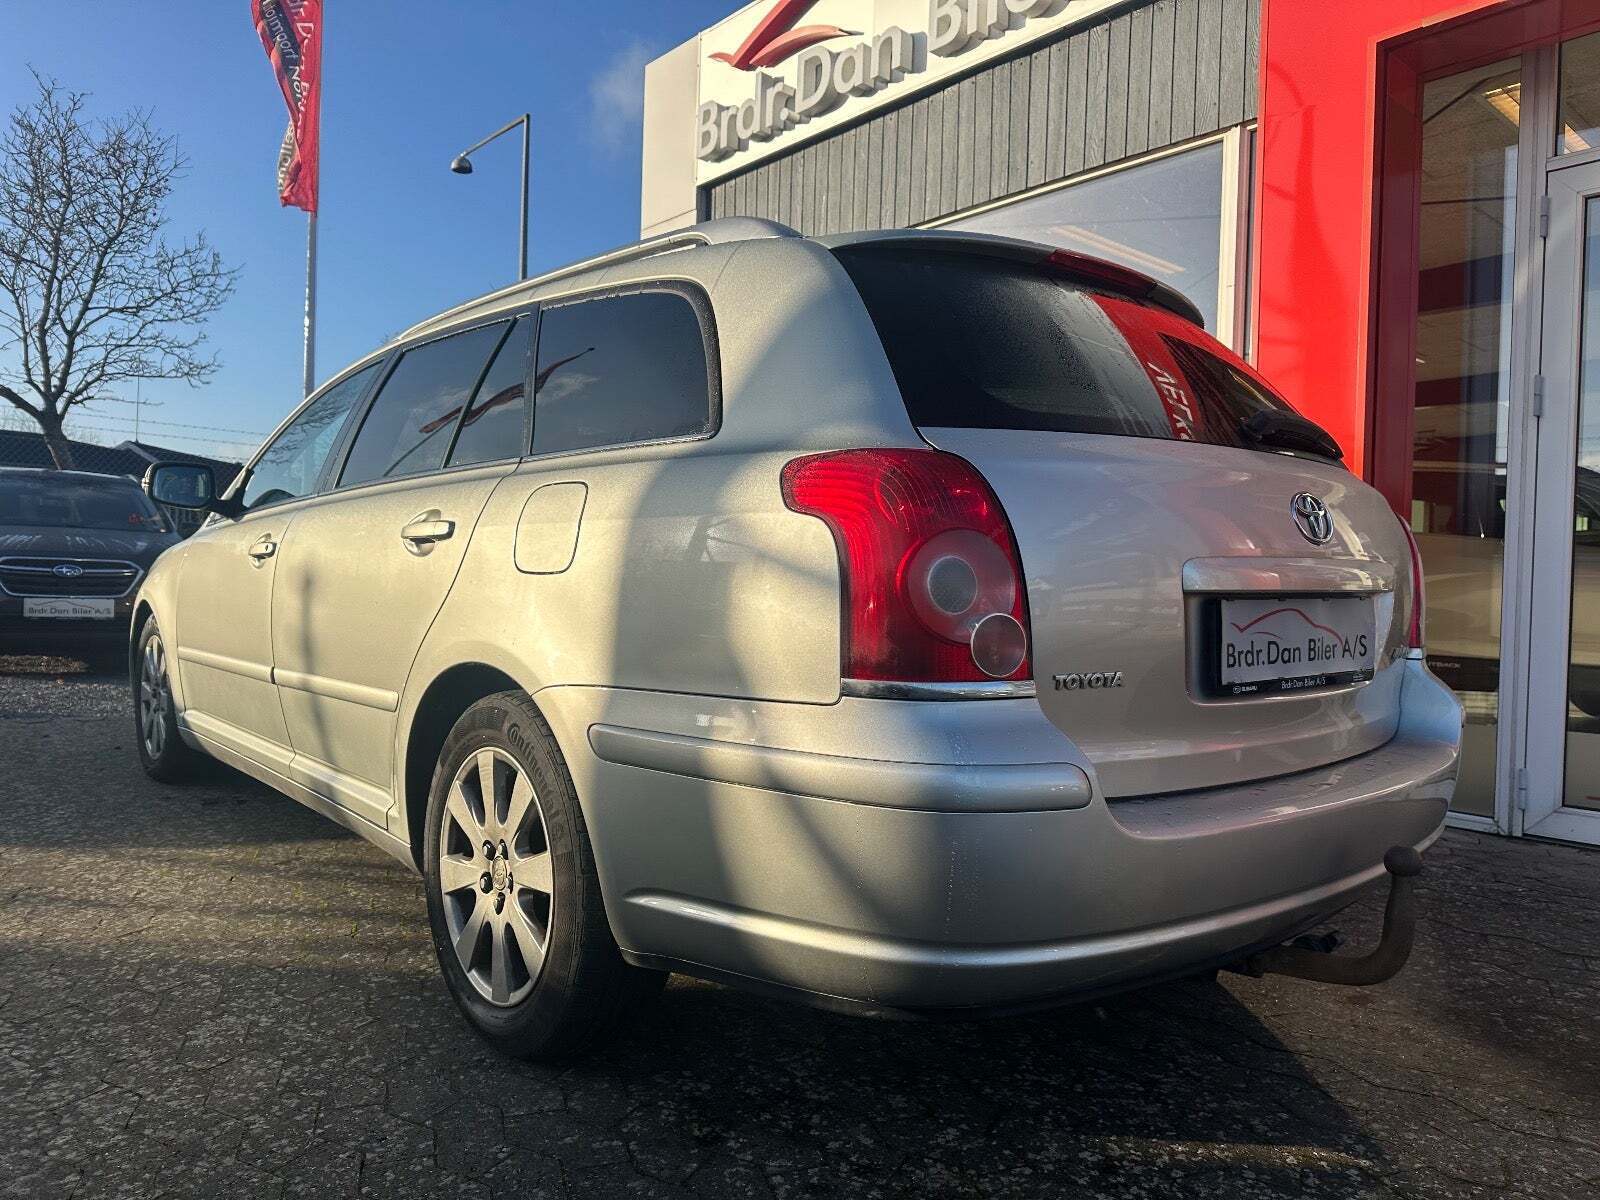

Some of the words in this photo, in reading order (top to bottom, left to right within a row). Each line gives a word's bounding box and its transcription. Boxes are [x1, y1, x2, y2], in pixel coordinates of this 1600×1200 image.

[1308, 637, 1338, 662] Biler
[1342, 634, 1367, 658] A/S
[1053, 671, 1124, 690] TOYOTA
